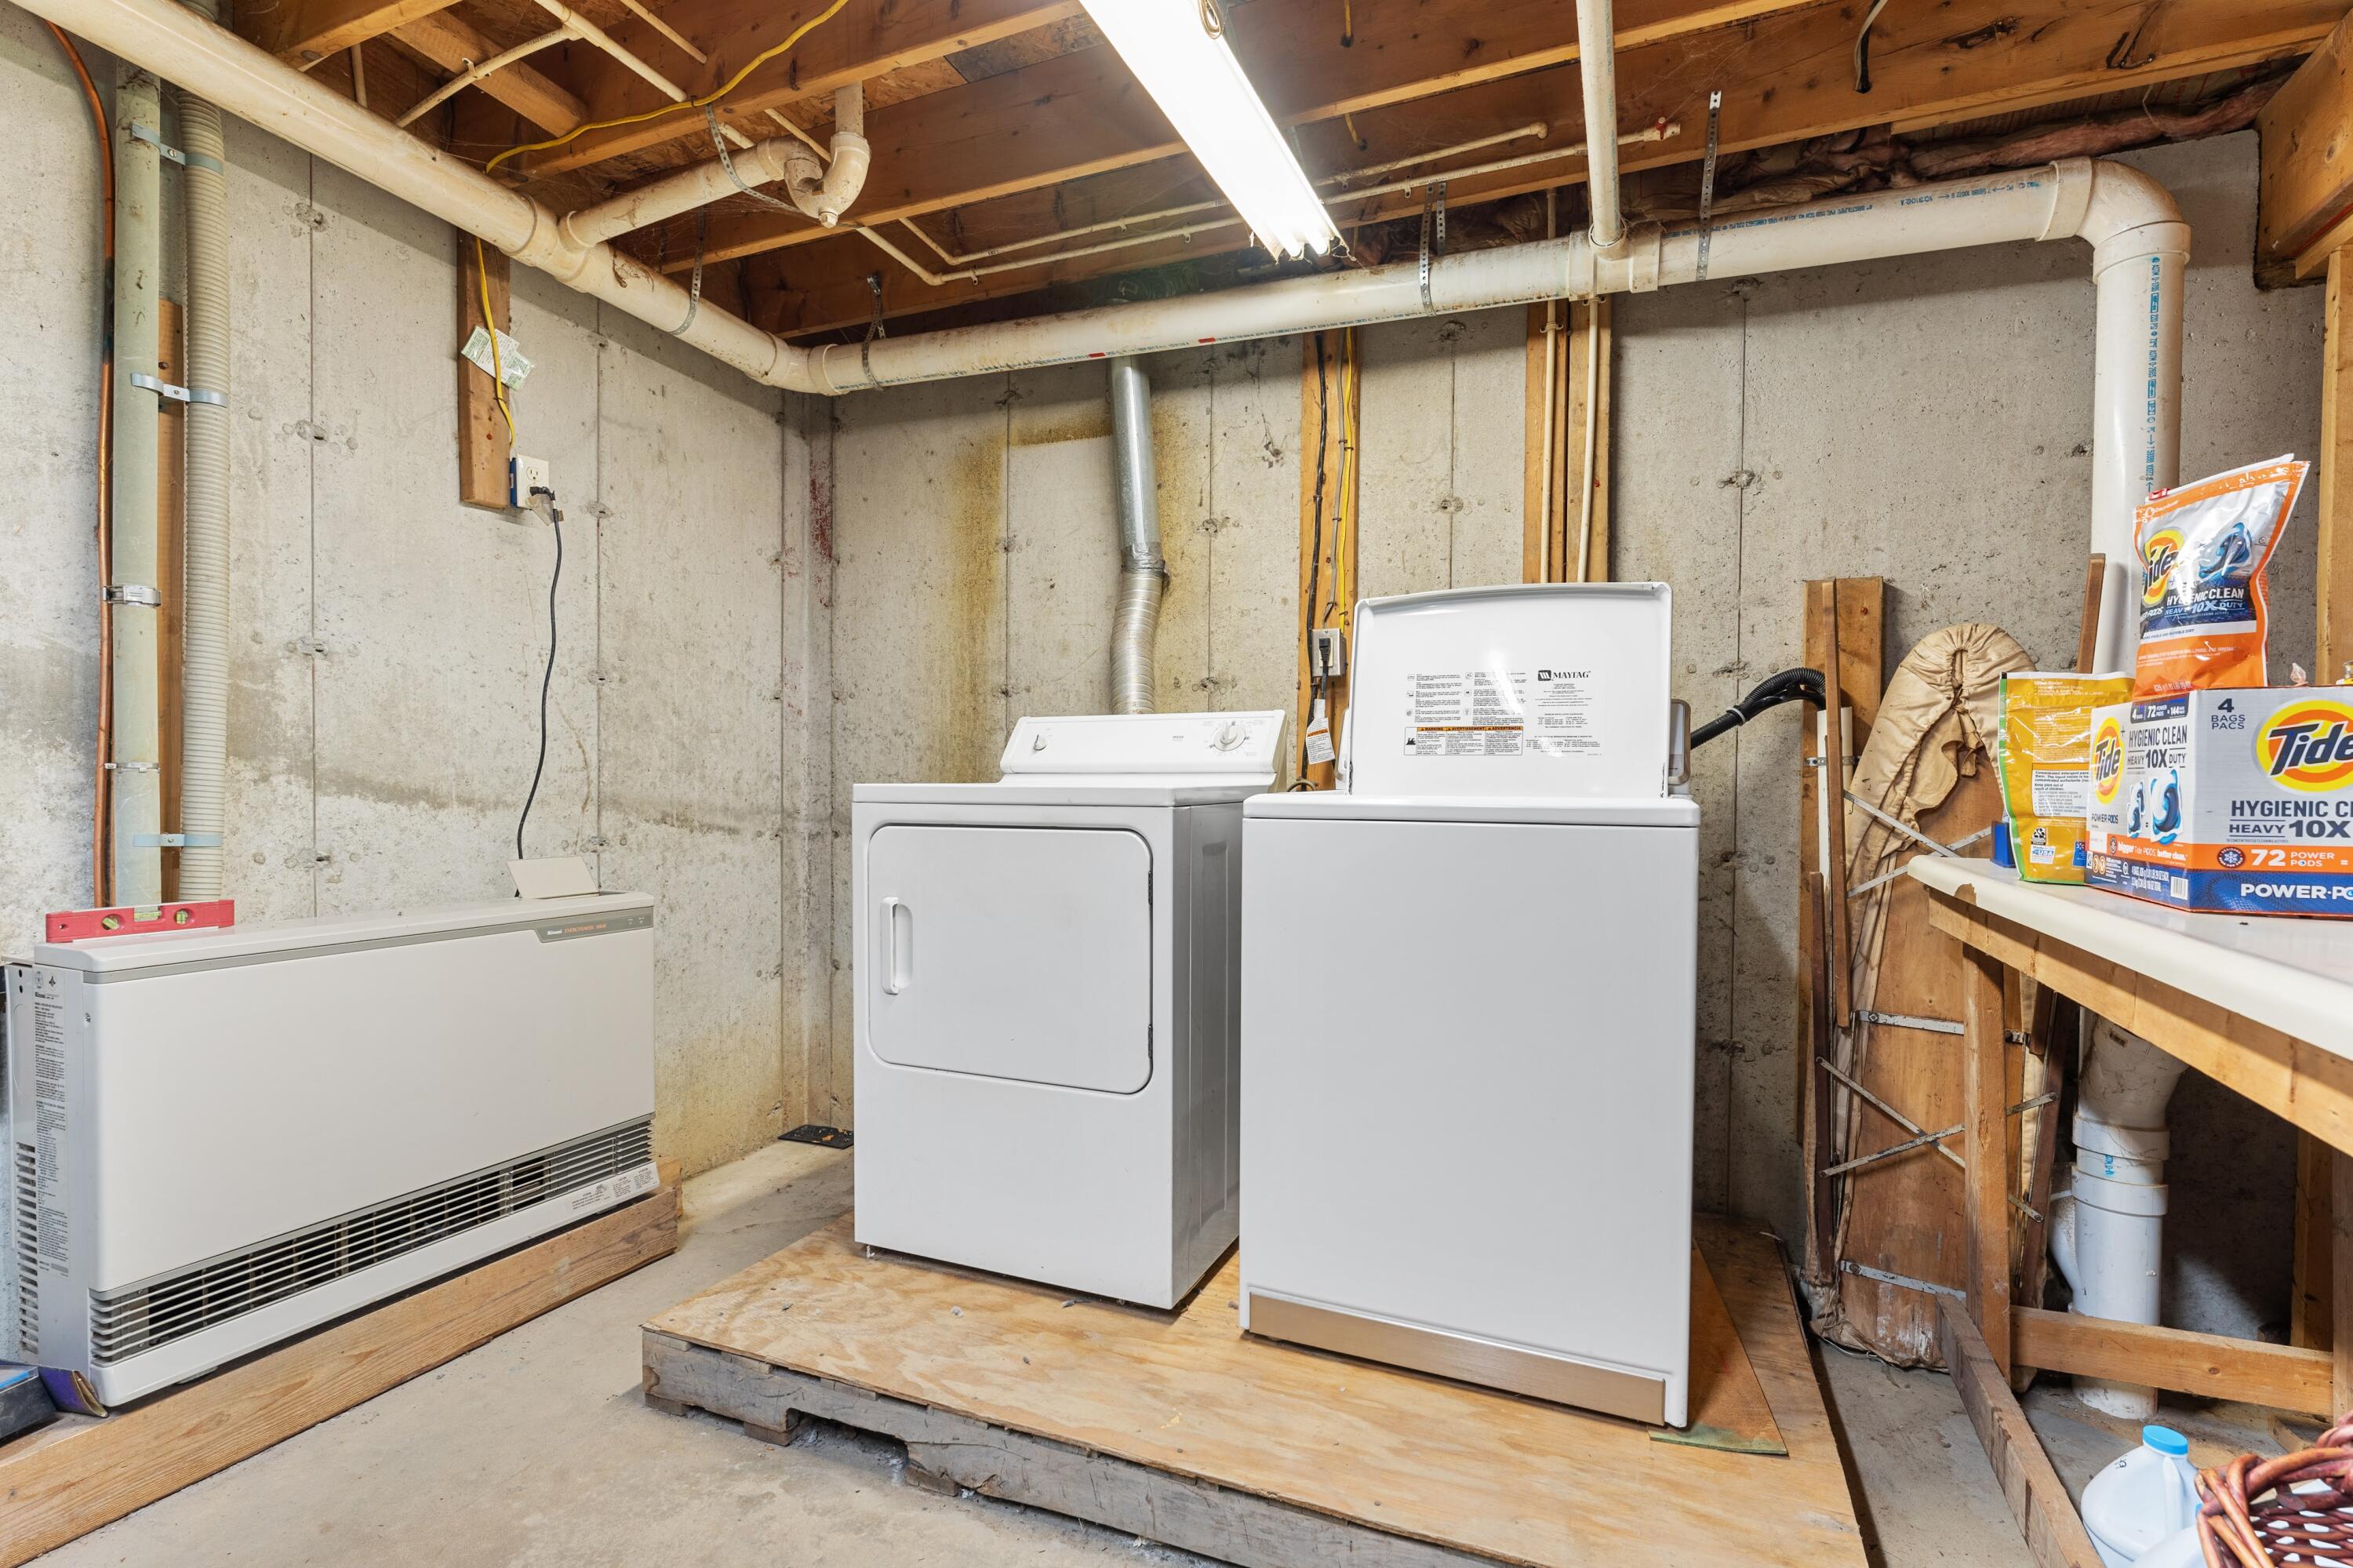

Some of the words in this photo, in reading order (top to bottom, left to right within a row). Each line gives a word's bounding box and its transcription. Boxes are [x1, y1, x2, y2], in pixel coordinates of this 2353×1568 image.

[2142, 542, 2179, 597] Tide
[2209, 588, 2244, 600] CLEAN
[2191, 600, 2218, 613] 10X
[2132, 708, 2137, 719] 4
[2148, 705, 2156, 718] 72
[2218, 698, 2234, 712] 4
[2211, 714, 2246, 722] BAGS
[2129, 729, 2160, 748] HYGIENIC
[2162, 725, 2188, 745] CLEAN
[2267, 722, 2353, 777] Tide
[2095, 739, 2121, 782] Tide
[2127, 755, 2144, 767] HEAVY
[2146, 749, 2168, 769] 10X
[2169, 753, 2186, 764] DUTY
[2231, 800, 2328, 817] HYGIENIC
[2229, 824, 2286, 834] HEAVY
[2289, 820, 2351, 838] 10X
[2118, 841, 2133, 853] bigger
[2251, 849, 2286, 866] 72
